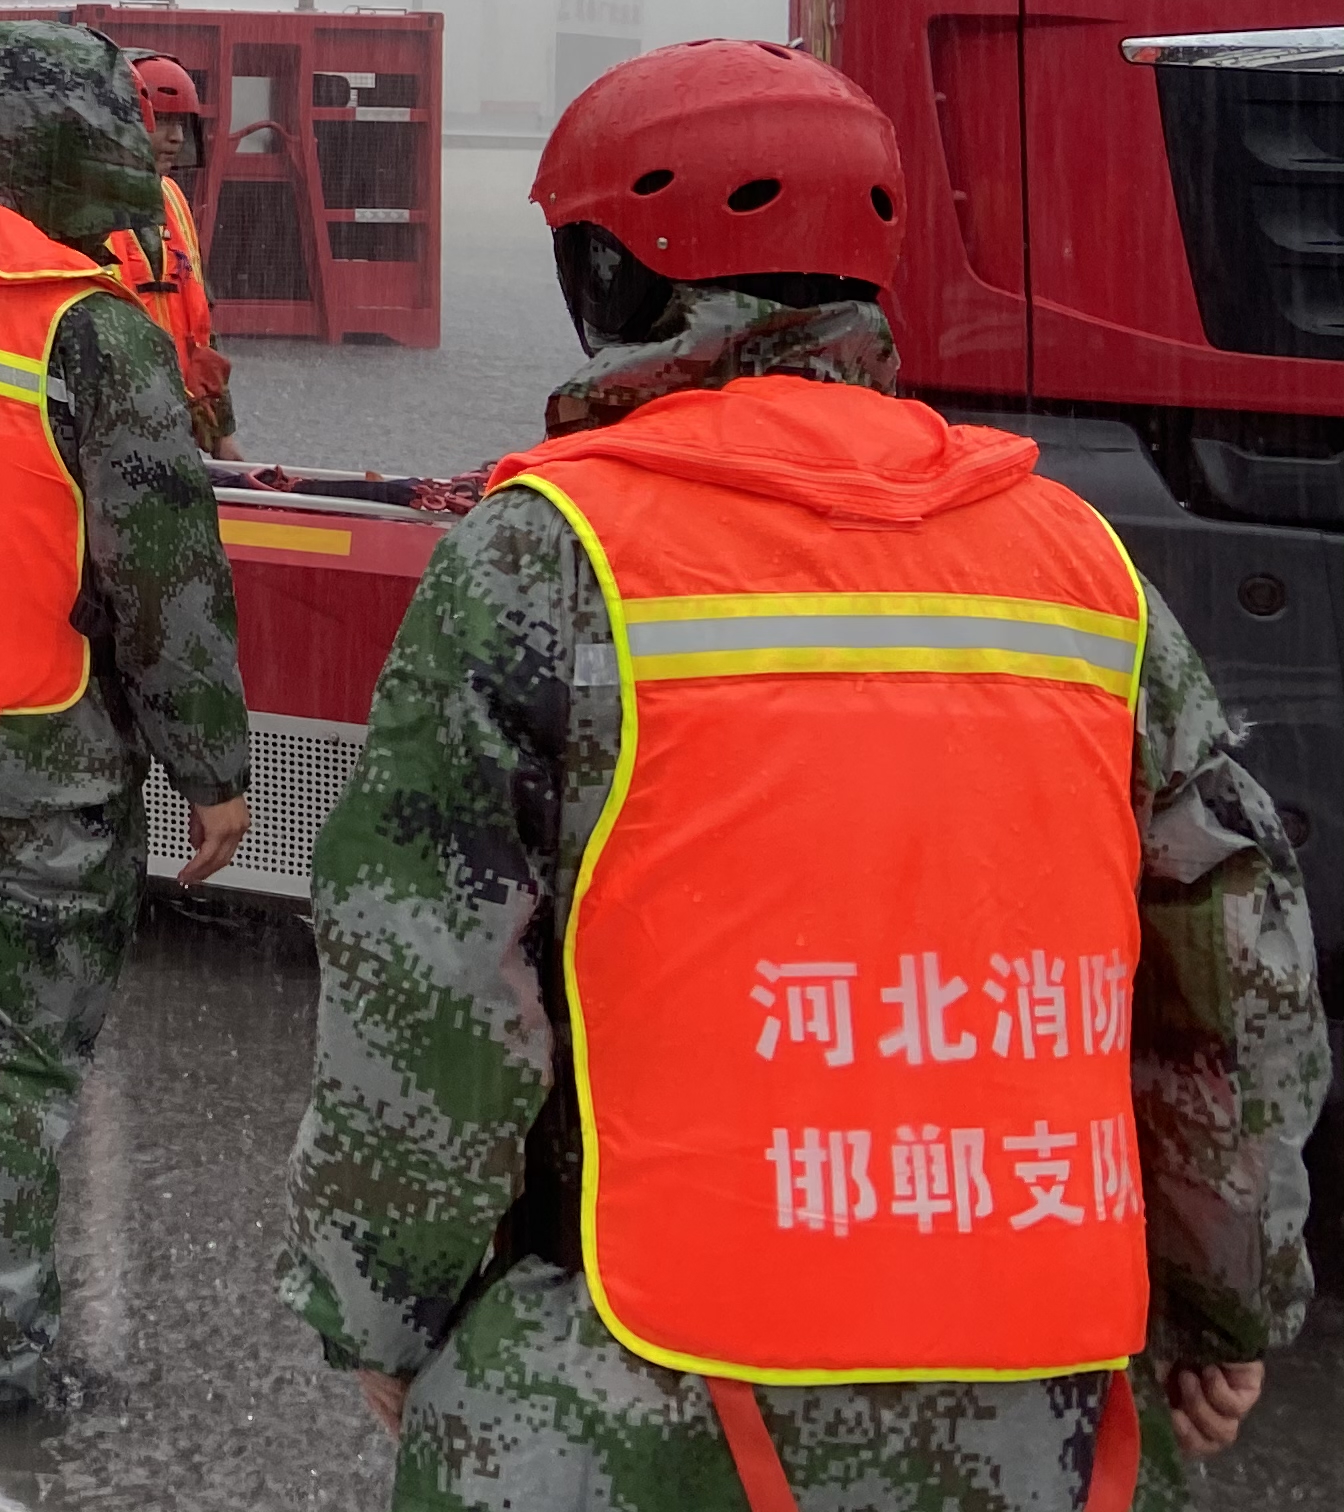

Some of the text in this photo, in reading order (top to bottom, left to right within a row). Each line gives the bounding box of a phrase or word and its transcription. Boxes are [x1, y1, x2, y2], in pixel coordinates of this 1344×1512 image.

[749, 948, 1128, 1068] 河北消防
[764, 1113, 1139, 1237] 邯郸支队
